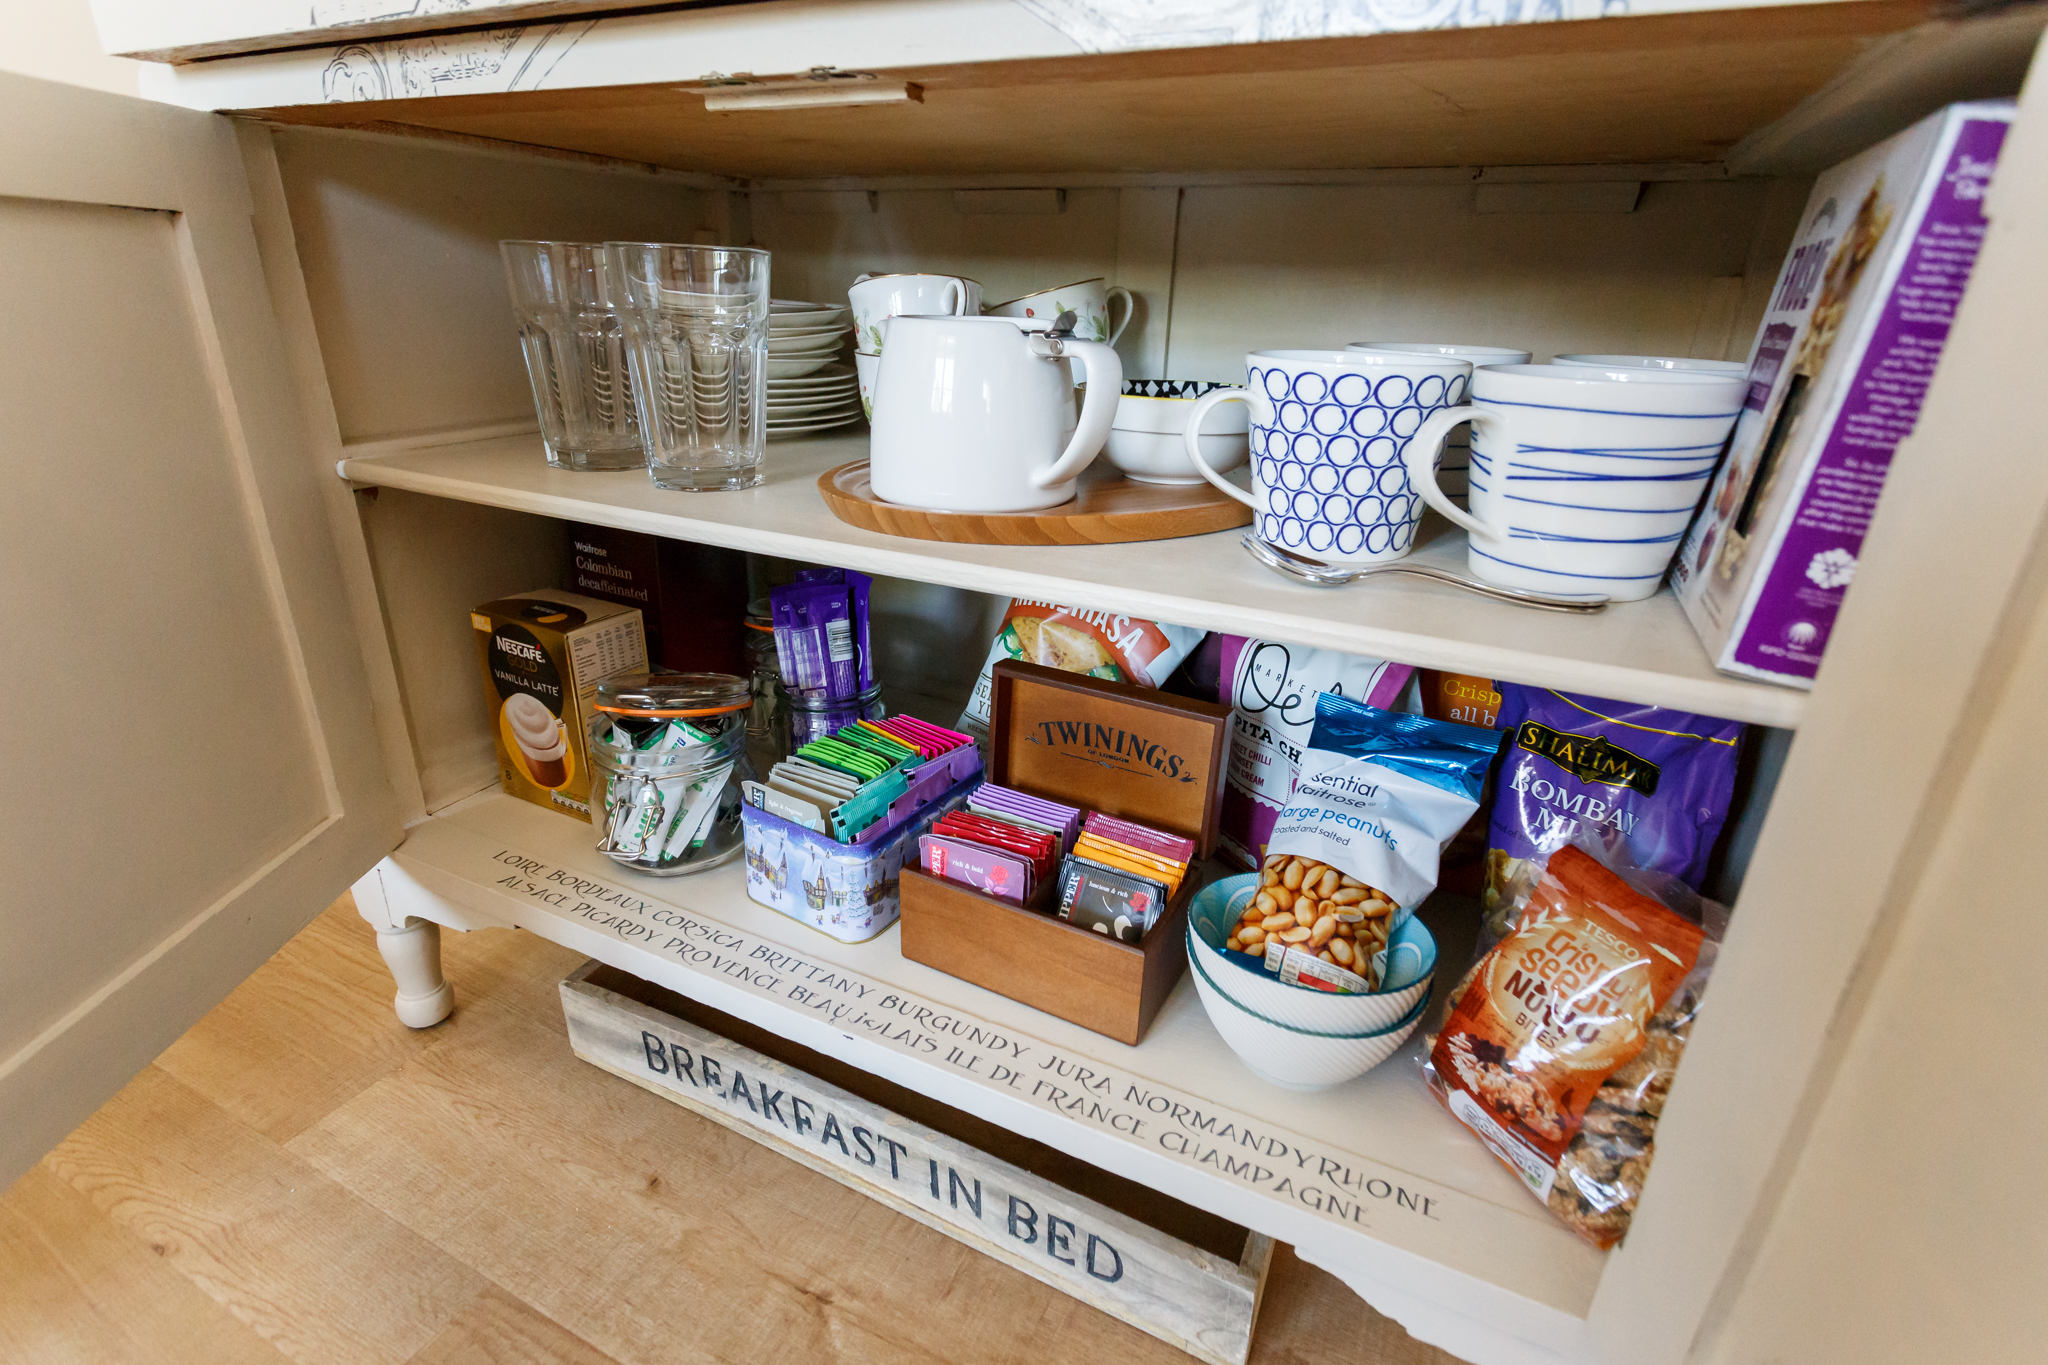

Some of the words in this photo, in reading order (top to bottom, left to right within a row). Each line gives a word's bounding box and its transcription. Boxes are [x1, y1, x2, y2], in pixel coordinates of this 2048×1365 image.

[574, 541, 607, 557] Waitrose
[576, 556, 632, 580] Colombian
[578, 574, 648, 601] decaffeinated
[1015, 598, 1144, 657] MASA
[495, 635, 543, 663] NESCAFÉ
[507, 653, 538, 673] GOLD
[495, 668, 530, 687] VANILLA
[532, 680, 559, 697] LATTE
[1255, 663, 1318, 699] MARKET
[1444, 679, 1501, 706] Crisp
[1450, 706, 1476, 724] all
[1038, 721, 1184, 778] TWININGS
[1234, 713, 1273, 746] PITA
[1279, 740, 1303, 767] CH
[1099, 752, 1130, 764] LONDON
[1248, 749, 1272, 767] CHILLI
[1523, 728, 1650, 790] SHALIMAR
[1241, 769, 1265, 787] CREAM
[1509, 769, 1640, 836] BOMBAY
[1274, 824, 1300, 834] roasted
[1300, 825, 1318, 834] and
[1318, 828, 1351, 846] salted
[1280, 805, 1319, 822] large
[1319, 808, 1398, 851] peanuts
[932, 847, 942, 876] PER
[1117, 890, 1128, 898] rich
[1585, 918, 1640, 960] TESCO
[492, 850, 549, 877] LOIRE
[546, 870, 652, 915] BORDEAUX
[652, 910, 744, 952] CORSICA
[749, 944, 877, 1000] BRITTANY
[879, 994, 1031, 1059] BURGUNDY
[1038, 1055, 1112, 1098] JURA
[497, 876, 573, 908] ALSACE
[570, 902, 664, 942] PICARDY
[663, 938, 786, 994] PROVENCE
[944, 1046, 983, 1074] ILE
[988, 1064, 1025, 1091] DE
[1031, 1079, 1149, 1140] FRANCE
[1159, 1131, 1372, 1228] CHAMPAGNE
[640, 1030, 907, 1181] BREAKFAST
[929, 1158, 983, 1220] IN
[1007, 1194, 1124, 1284] BED
